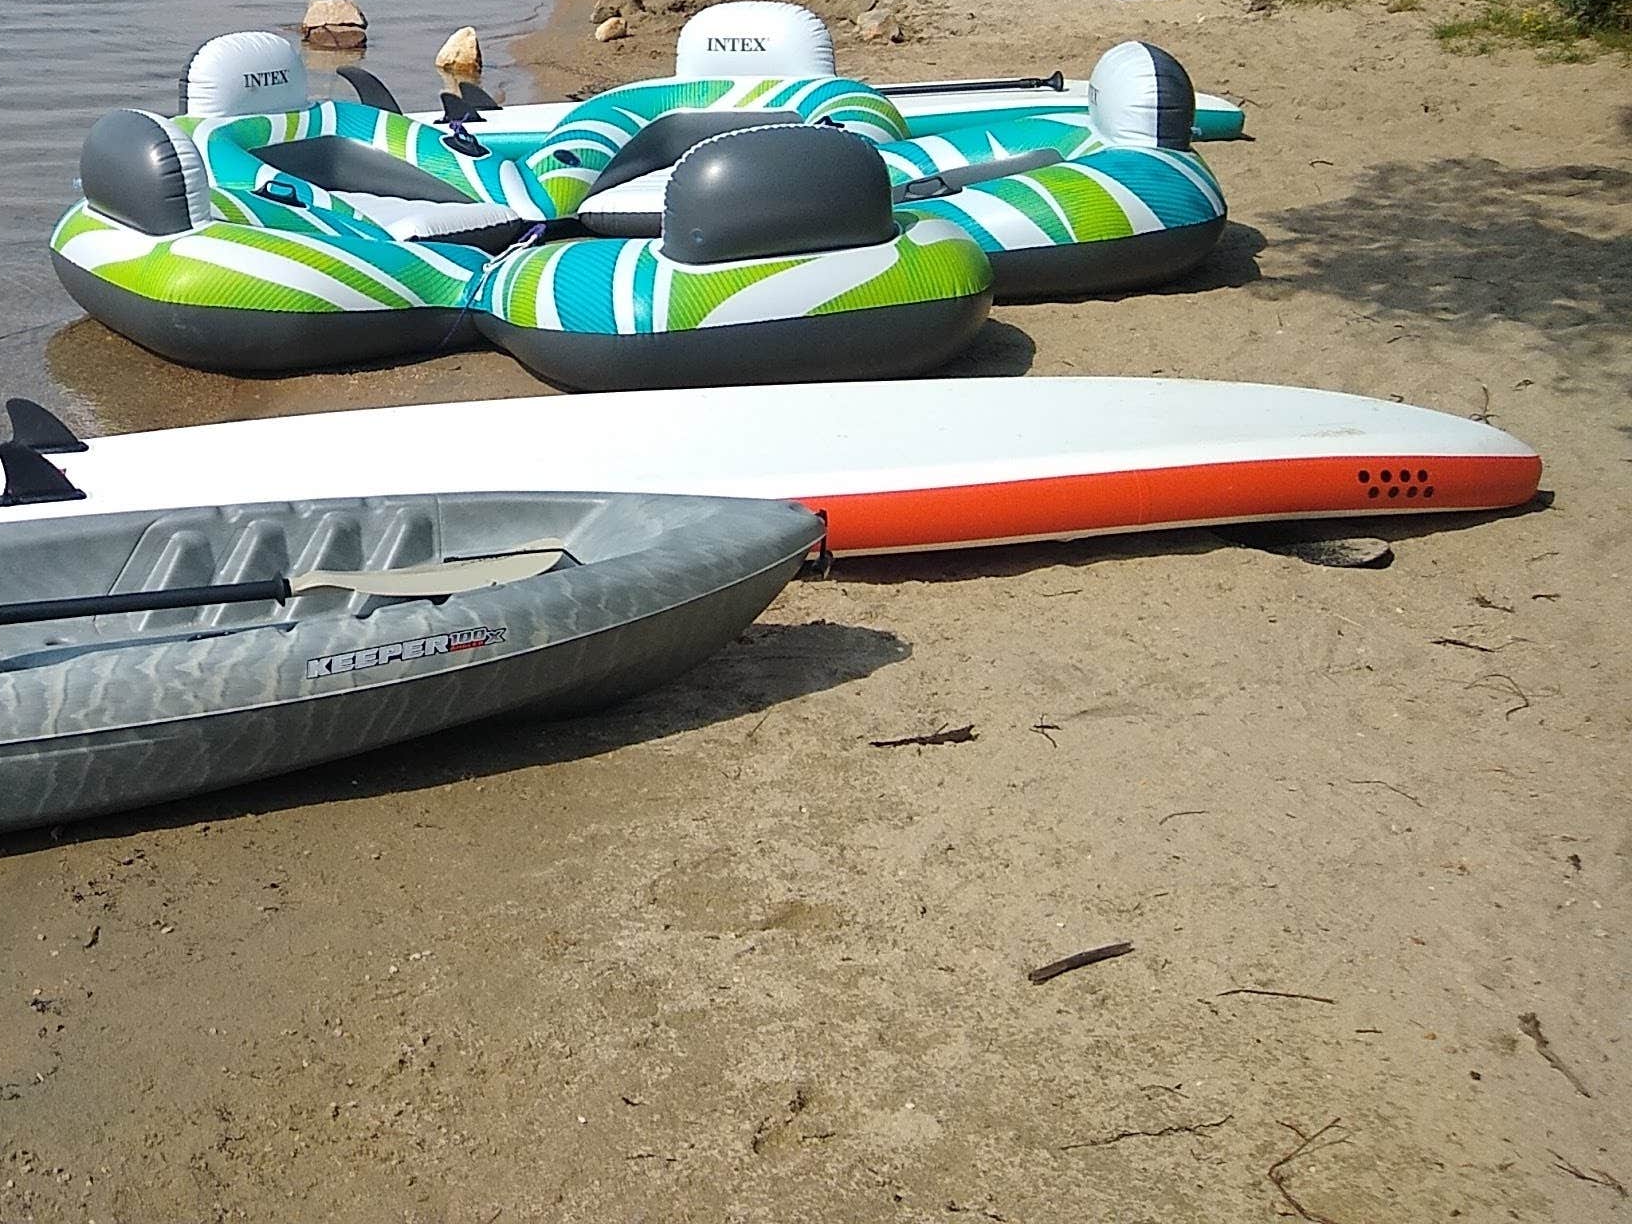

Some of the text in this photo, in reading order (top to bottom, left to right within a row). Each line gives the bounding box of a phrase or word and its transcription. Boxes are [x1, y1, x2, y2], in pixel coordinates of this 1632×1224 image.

[707, 37, 767, 52] INTEX
[243, 69, 289, 88] INTEX
[306, 634, 449, 679] KEEPER
